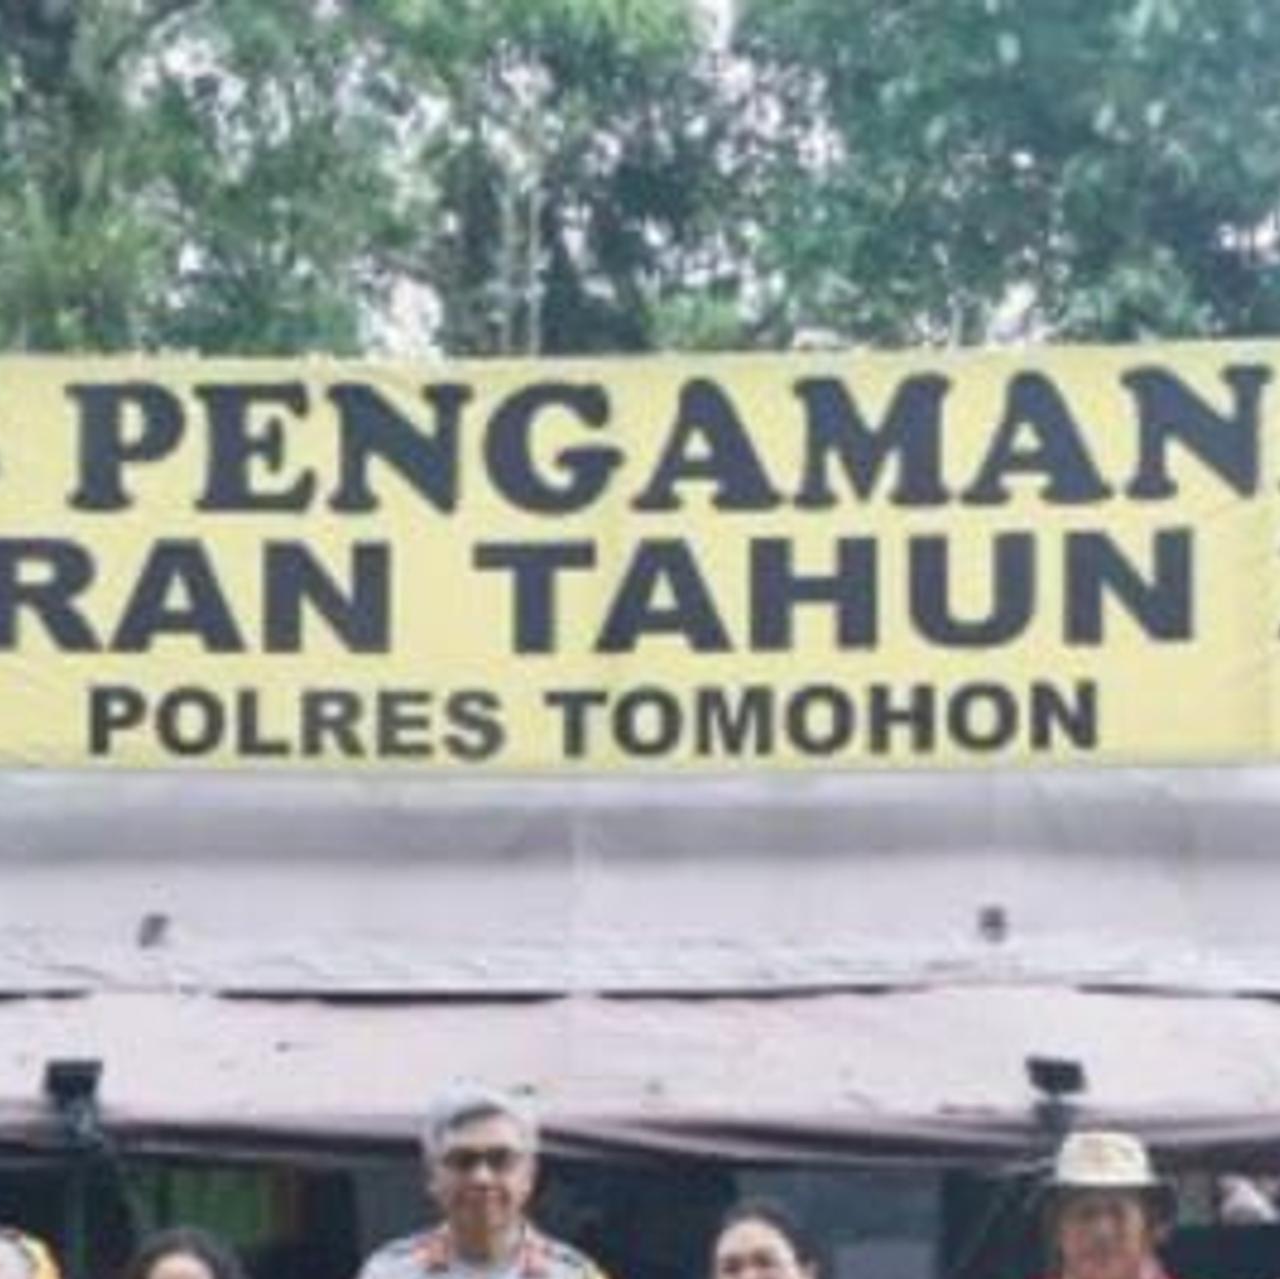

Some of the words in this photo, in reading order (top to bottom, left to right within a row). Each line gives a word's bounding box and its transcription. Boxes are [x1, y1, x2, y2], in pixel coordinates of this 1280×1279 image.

[471, 526, 1195, 657] TAHUN
[87, 684, 506, 763] POLRES
[542, 679, 1099, 761] TOMOHON
